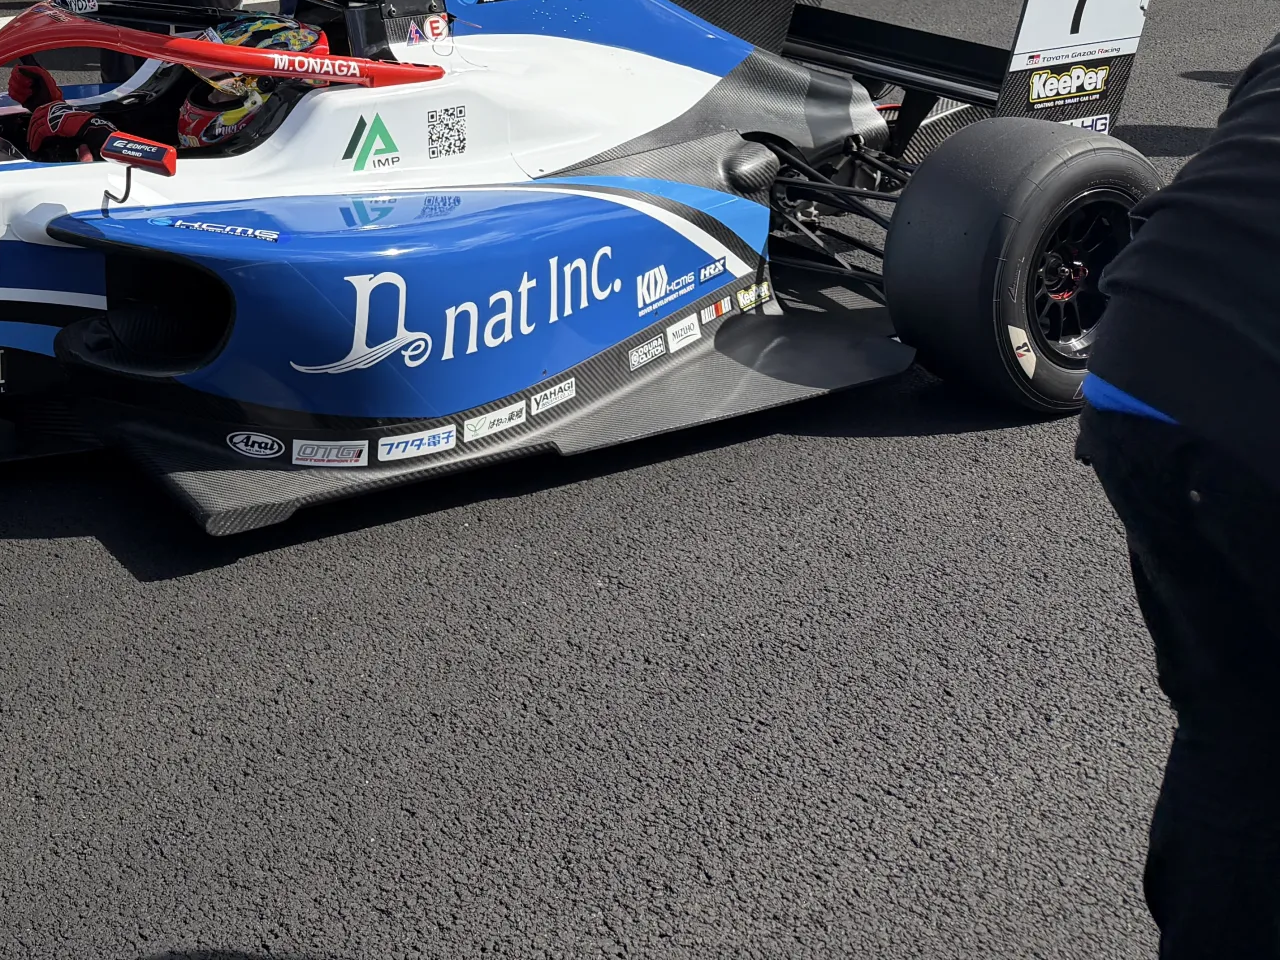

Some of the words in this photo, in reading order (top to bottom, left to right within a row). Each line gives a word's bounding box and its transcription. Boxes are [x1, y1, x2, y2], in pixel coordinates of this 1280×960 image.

[429, 20, 443, 37] E
[1042, 54, 1070, 63] TOYOTA
[1097, 47, 1121, 55] Racing
[273, 54, 360, 77] M.ONAGA
[1030, 66, 1109, 100] KeePer
[1034, 102, 1055, 110] COATING
[122, 149, 142, 157] CASIO
[126, 143, 158, 153] EDIFICE
[372, 156, 400, 169] IMP
[699, 259, 725, 280] HRX
[548, 245, 622, 324] Inc.
[666, 271, 695, 294] KCMG
[652, 293, 678, 310] DEVELOPMENT
[678, 284, 695, 298] PROJECT
[672, 323, 695, 341] MIZUHO
[638, 337, 662, 355] OGURA
[639, 345, 664, 363] CLUTCH
[533, 379, 575, 410] YAHAGI
[232, 435, 277, 451] Arai
[381, 429, 455, 456] フクダ電子
